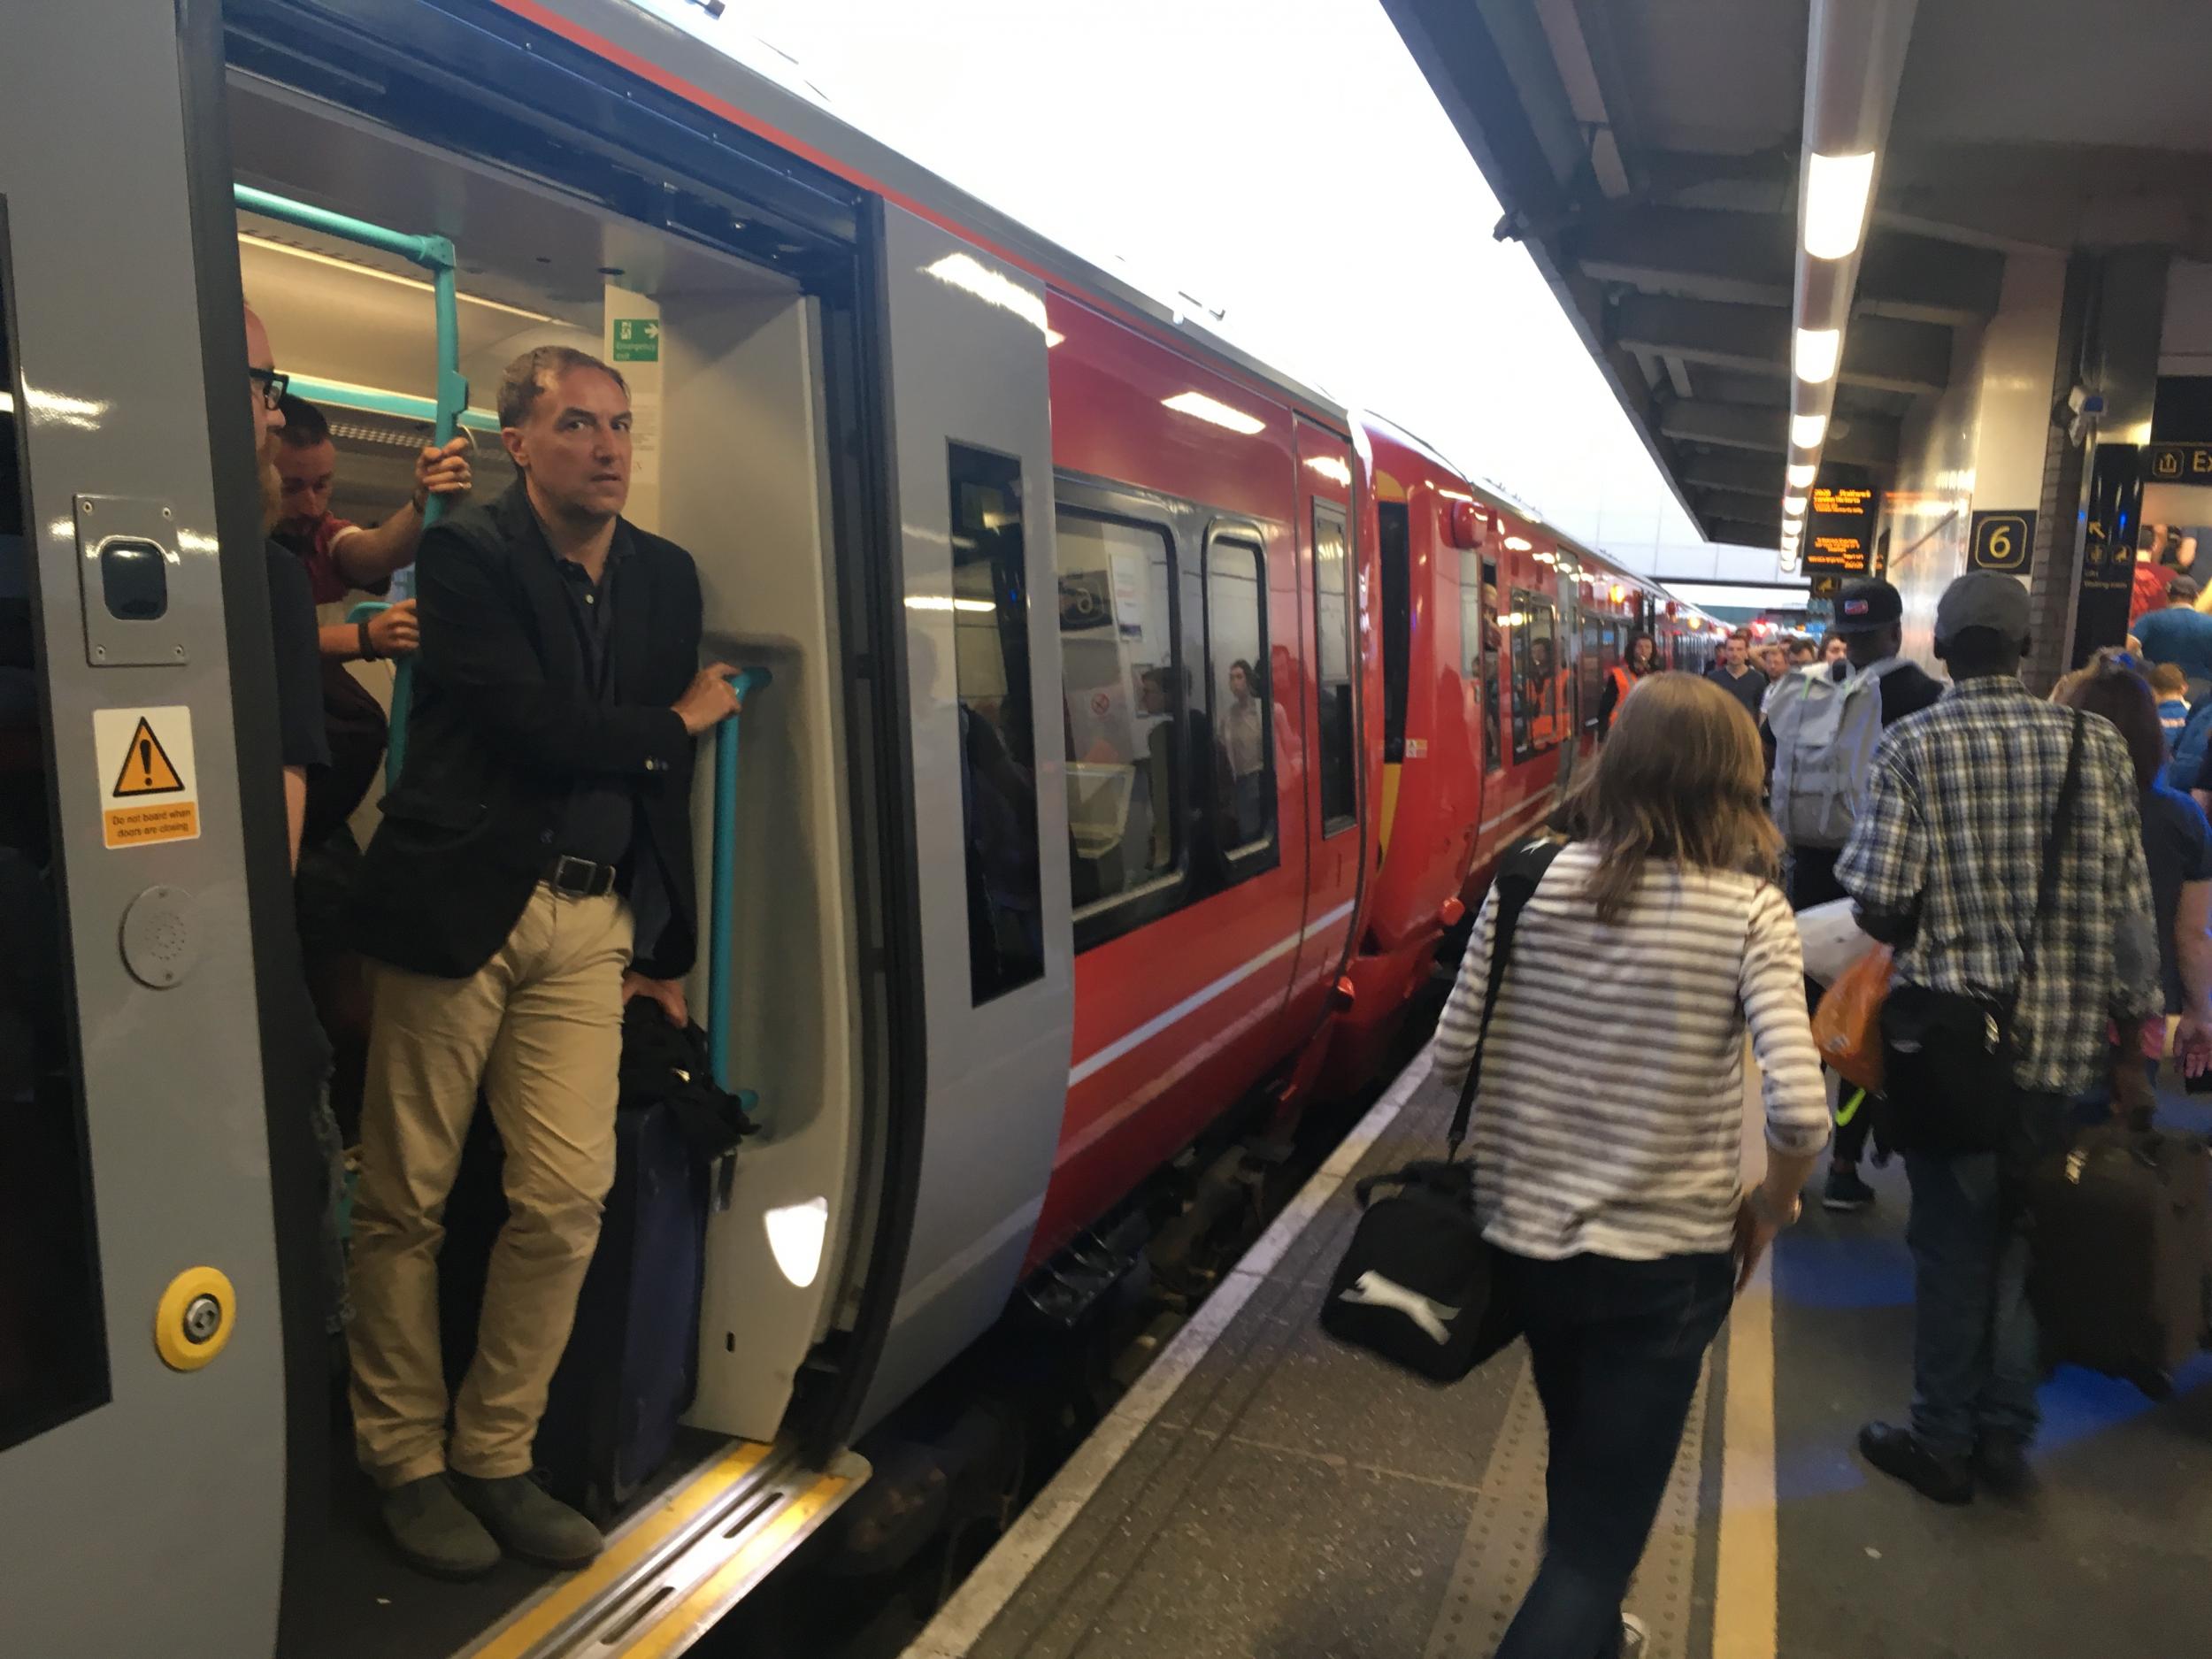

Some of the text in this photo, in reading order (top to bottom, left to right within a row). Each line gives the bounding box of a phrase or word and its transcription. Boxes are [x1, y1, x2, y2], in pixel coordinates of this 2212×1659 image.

[1989, 525, 2011, 559] 6
[112, 816, 125, 826] Do
[127, 814, 142, 824] not
[169, 810, 191, 818] when
[144, 826, 157, 835] are
